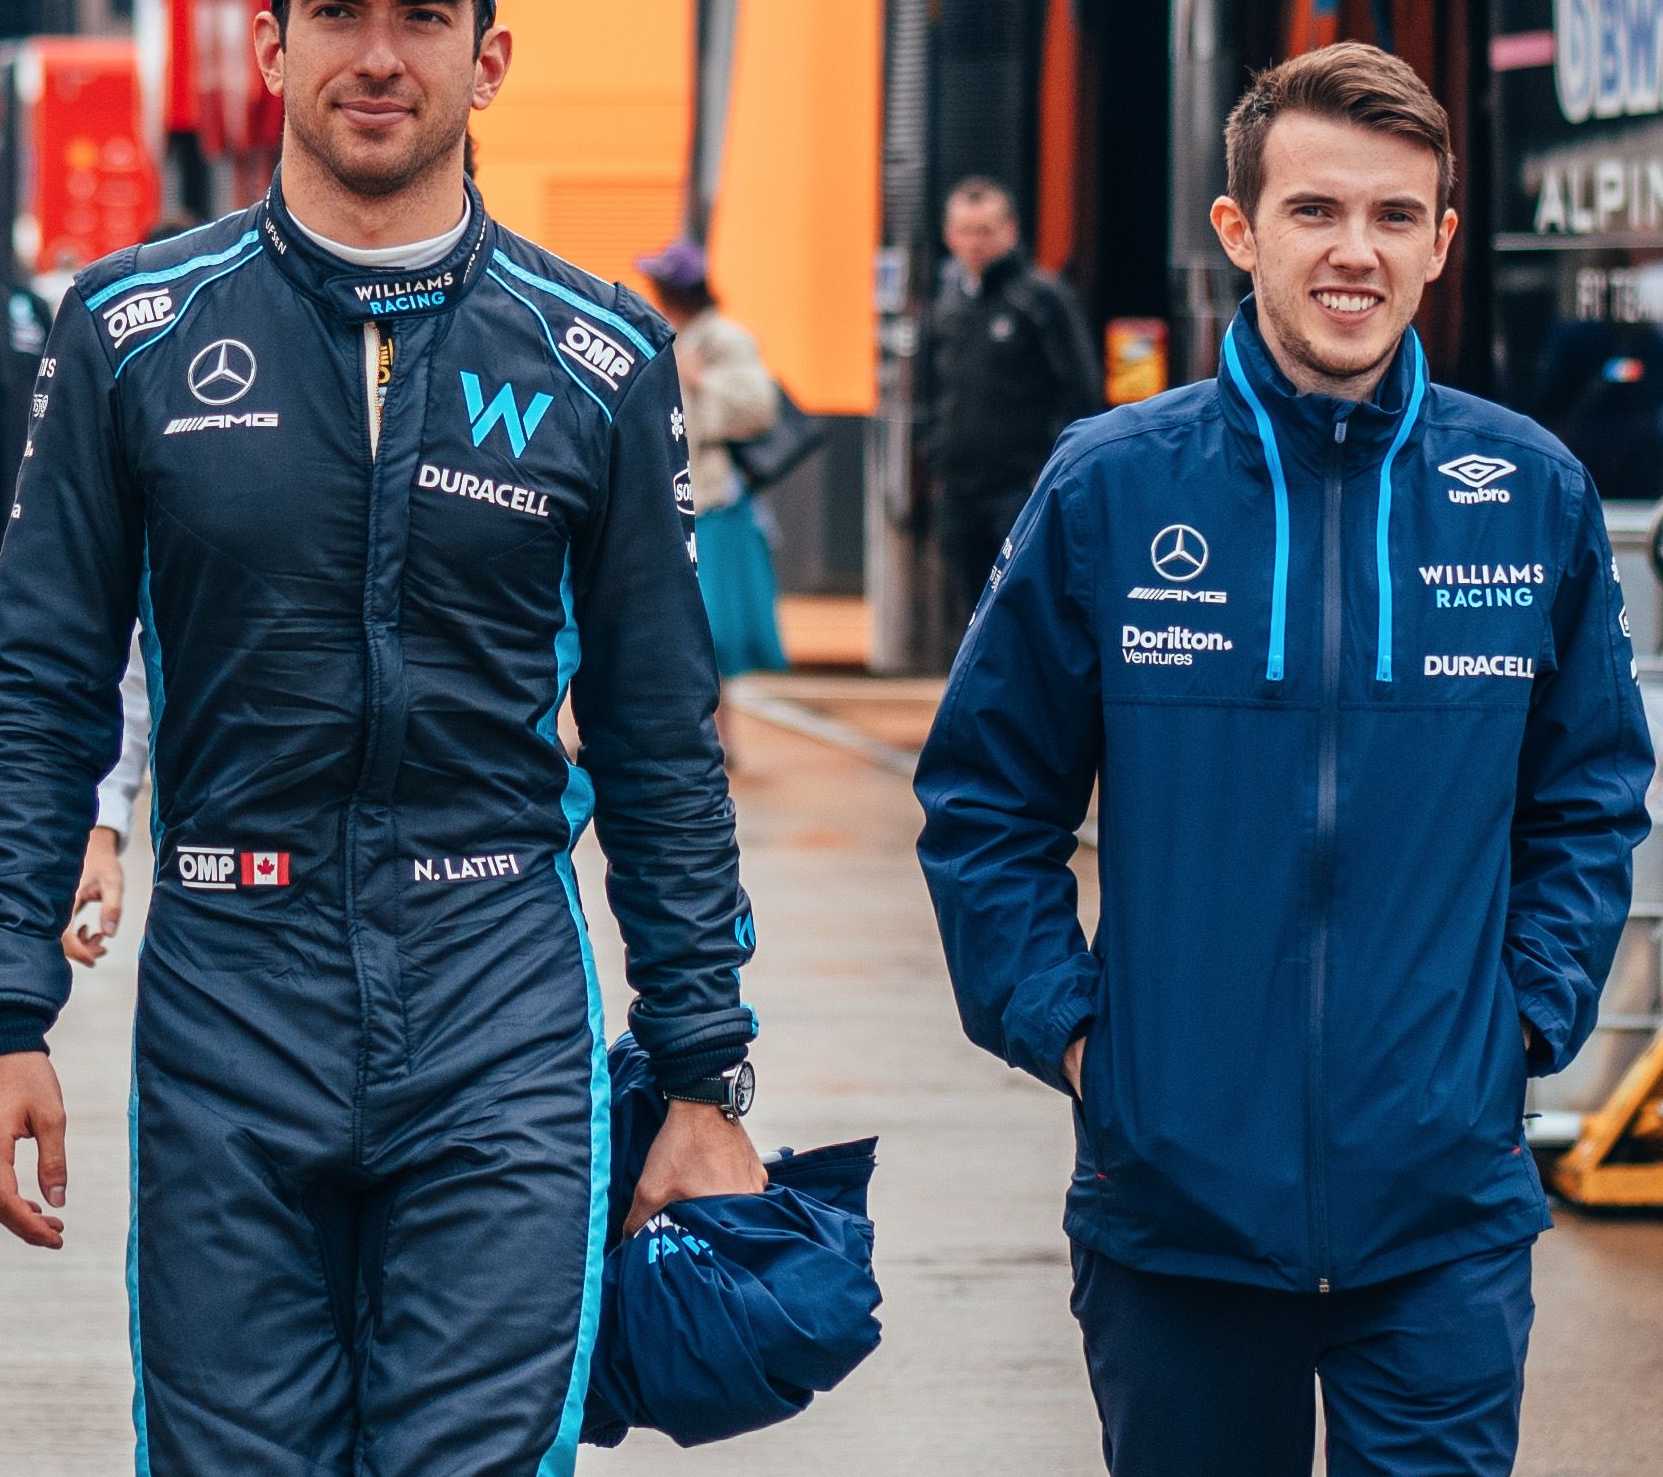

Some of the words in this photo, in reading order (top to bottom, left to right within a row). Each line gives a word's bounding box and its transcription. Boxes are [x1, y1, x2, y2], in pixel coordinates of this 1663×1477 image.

[354, 272, 454, 302] WILLIAMS
[369, 290, 446, 315] RACING
[108, 296, 173, 338] OMP
[565, 326, 630, 378] OMP
[201, 412, 280, 430] AMG
[460, 371, 554, 459] W
[418, 465, 549, 517] DURACELL
[1448, 488, 1511, 504] umbro
[1419, 564, 1545, 585] WILLIAMS
[1159, 589, 1227, 603] AMG
[1436, 587, 1534, 608] RACING
[1122, 648, 1193, 666] Ventures
[1424, 654, 1535, 679] DURACELL
[178, 853, 236, 882] OMP
[414, 859, 441, 881] N.
[444, 854, 520, 881] LATIFI
